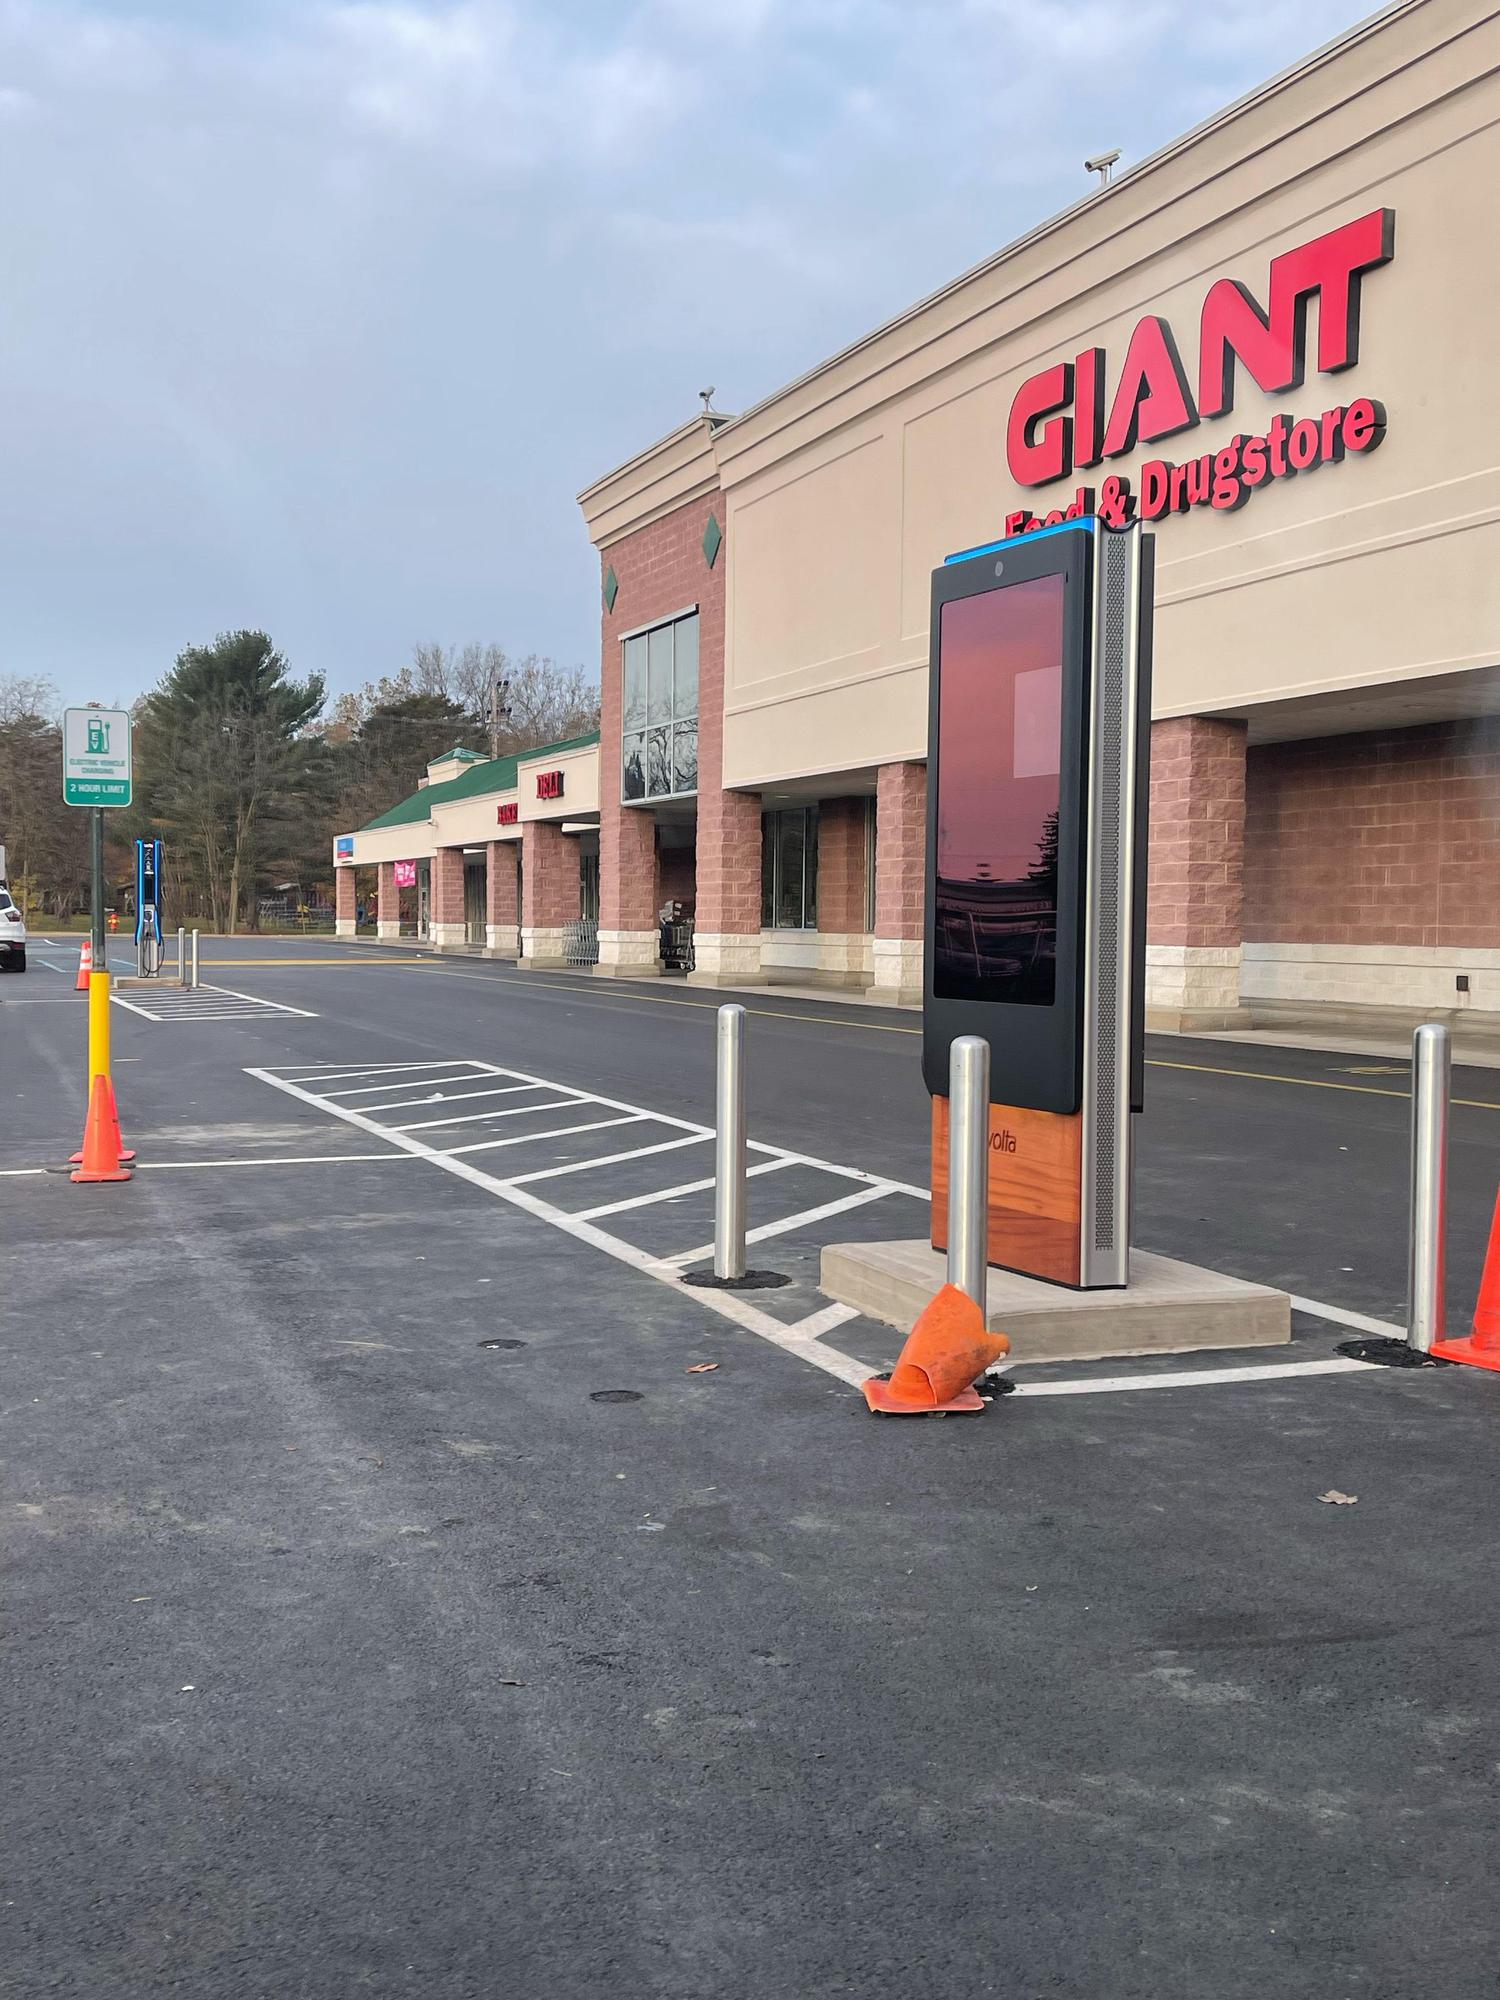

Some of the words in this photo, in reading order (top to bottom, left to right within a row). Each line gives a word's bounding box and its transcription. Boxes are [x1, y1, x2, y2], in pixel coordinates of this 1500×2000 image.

[1007, 207, 1394, 487] GIANT
[1099, 476, 1137, 528] &
[1141, 398, 1387, 521] Drugstore
[70, 783, 76, 792] 2
[77, 784, 101, 793] HOUR
[102, 784, 125, 794] LIMIT
